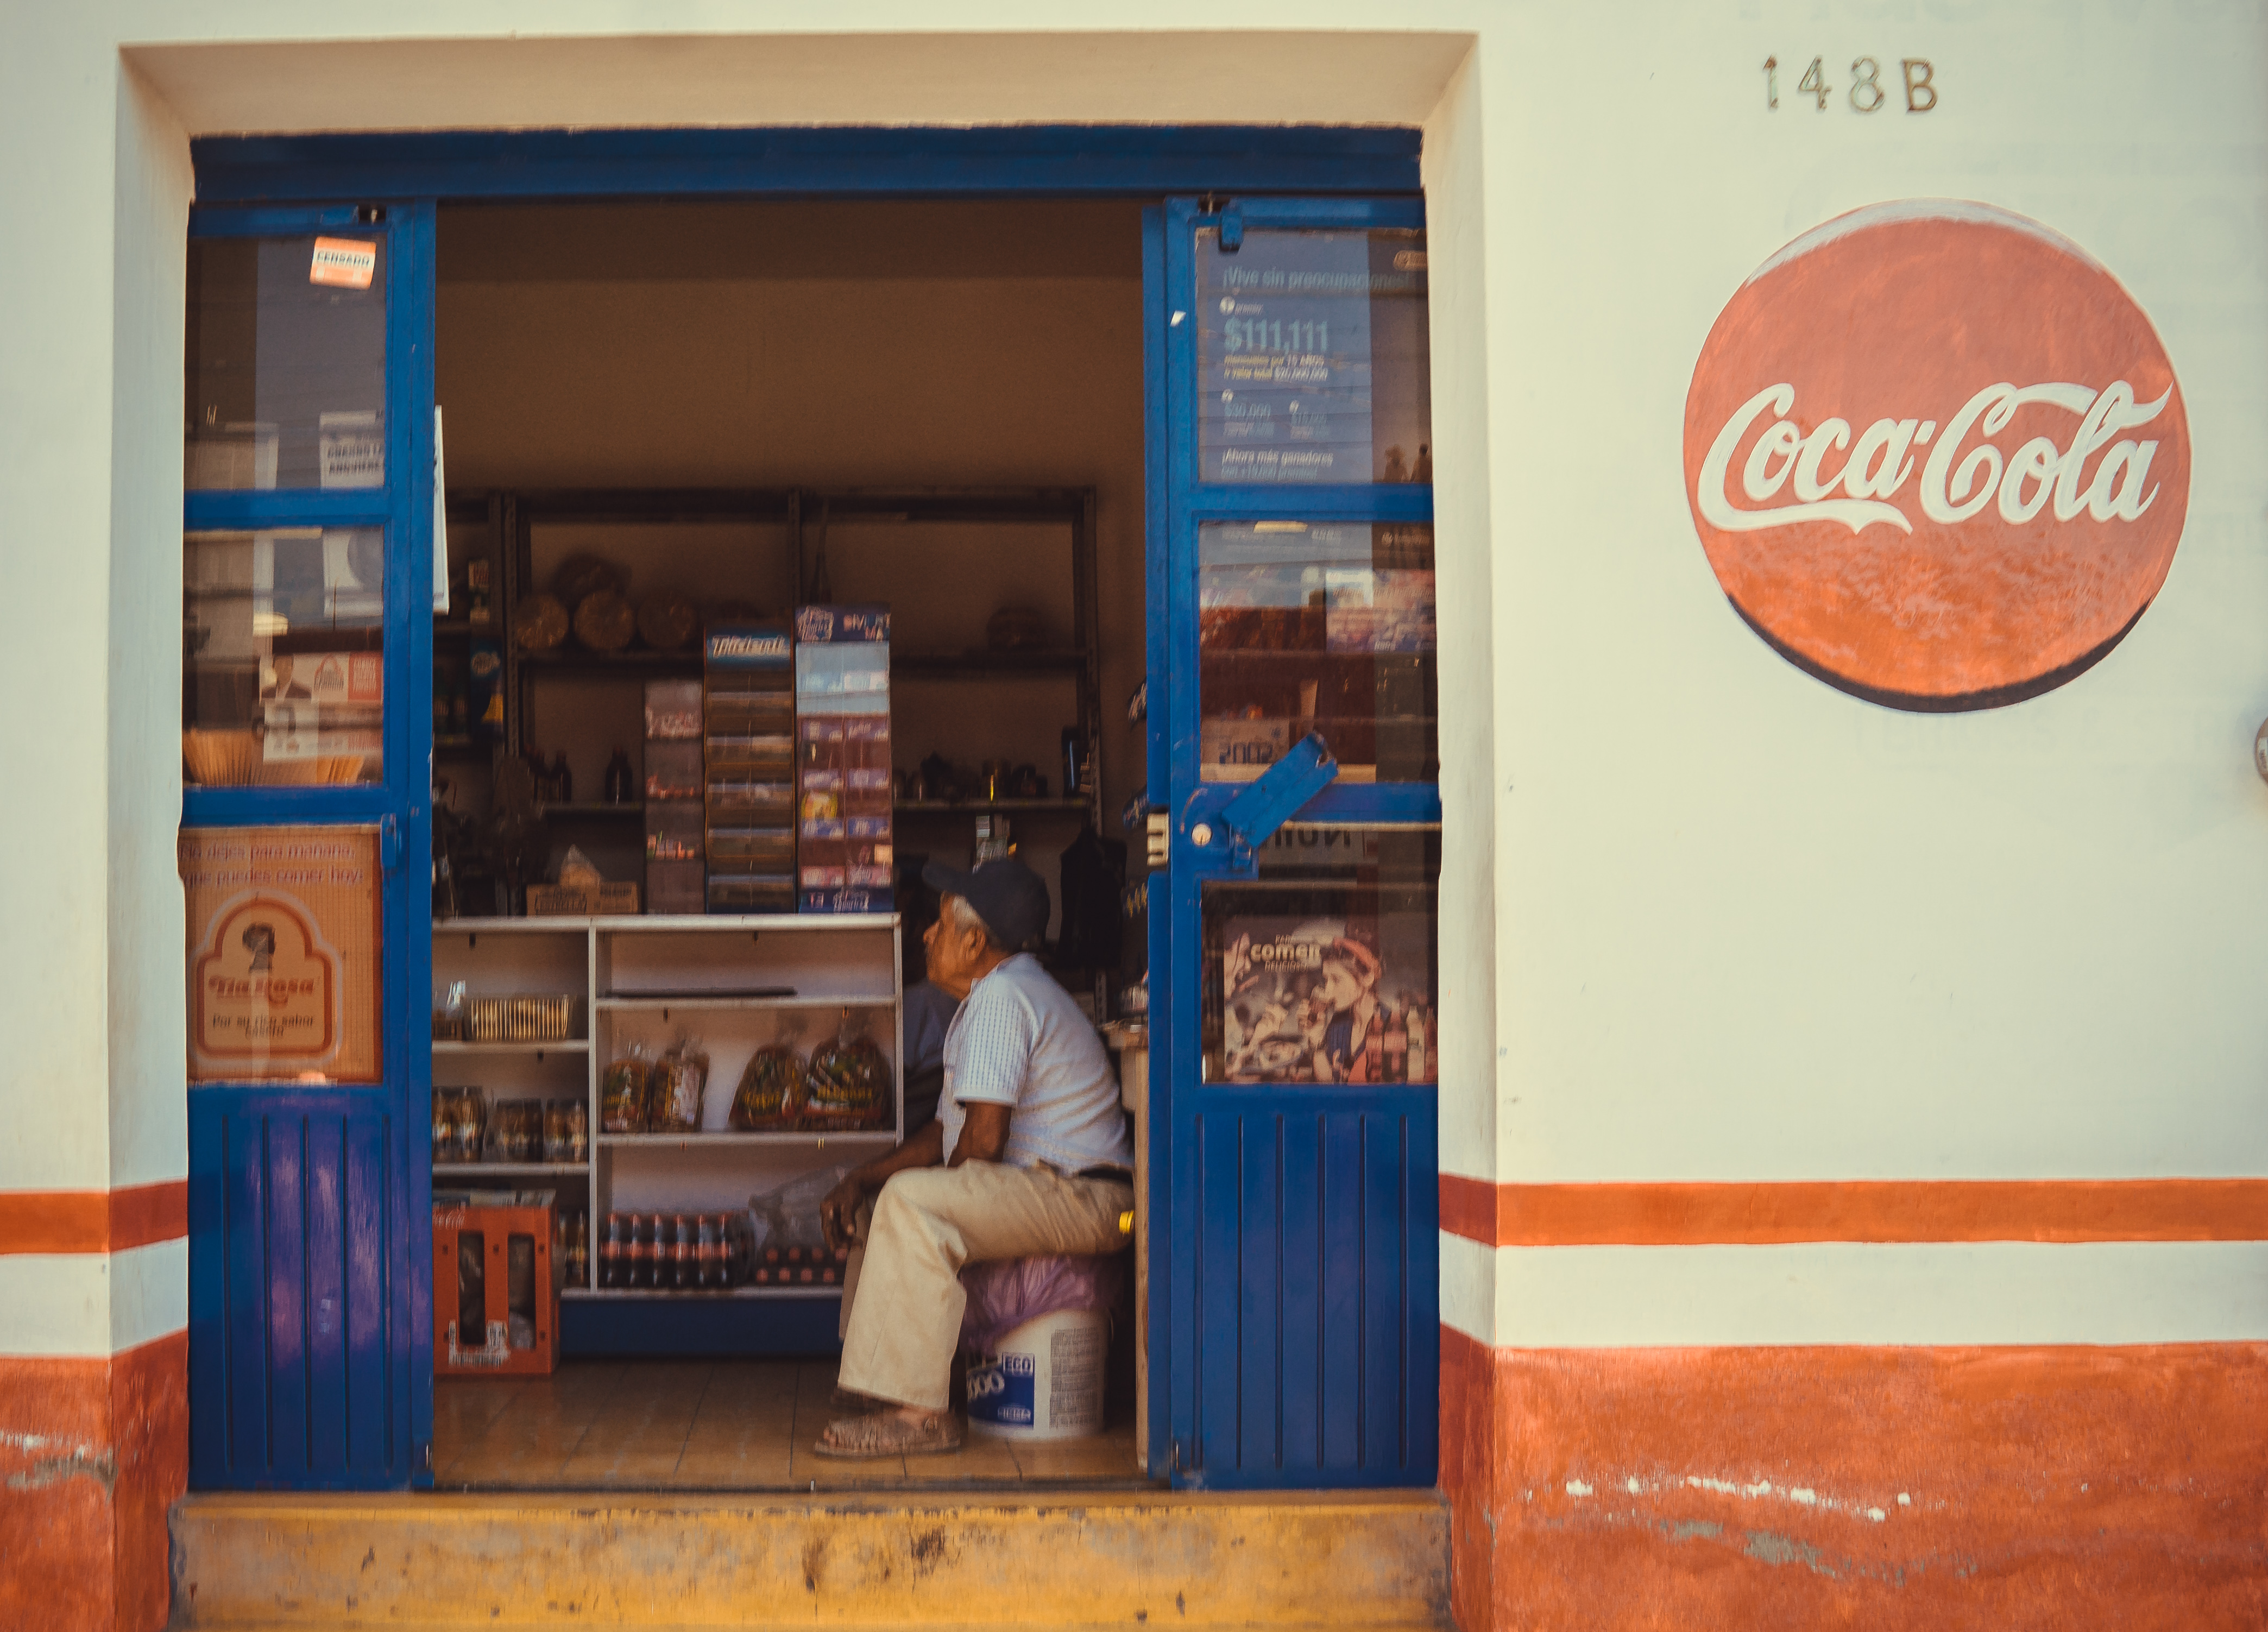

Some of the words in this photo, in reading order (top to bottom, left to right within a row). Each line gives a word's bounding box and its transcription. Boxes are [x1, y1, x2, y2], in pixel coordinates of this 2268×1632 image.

[1761, 54, 1939, 112] 148B
[317, 250, 369, 267] CENSADO
[1224, 317, 1328, 356] $111,111
[1697, 380, 2174, 536] Coca-Cola
